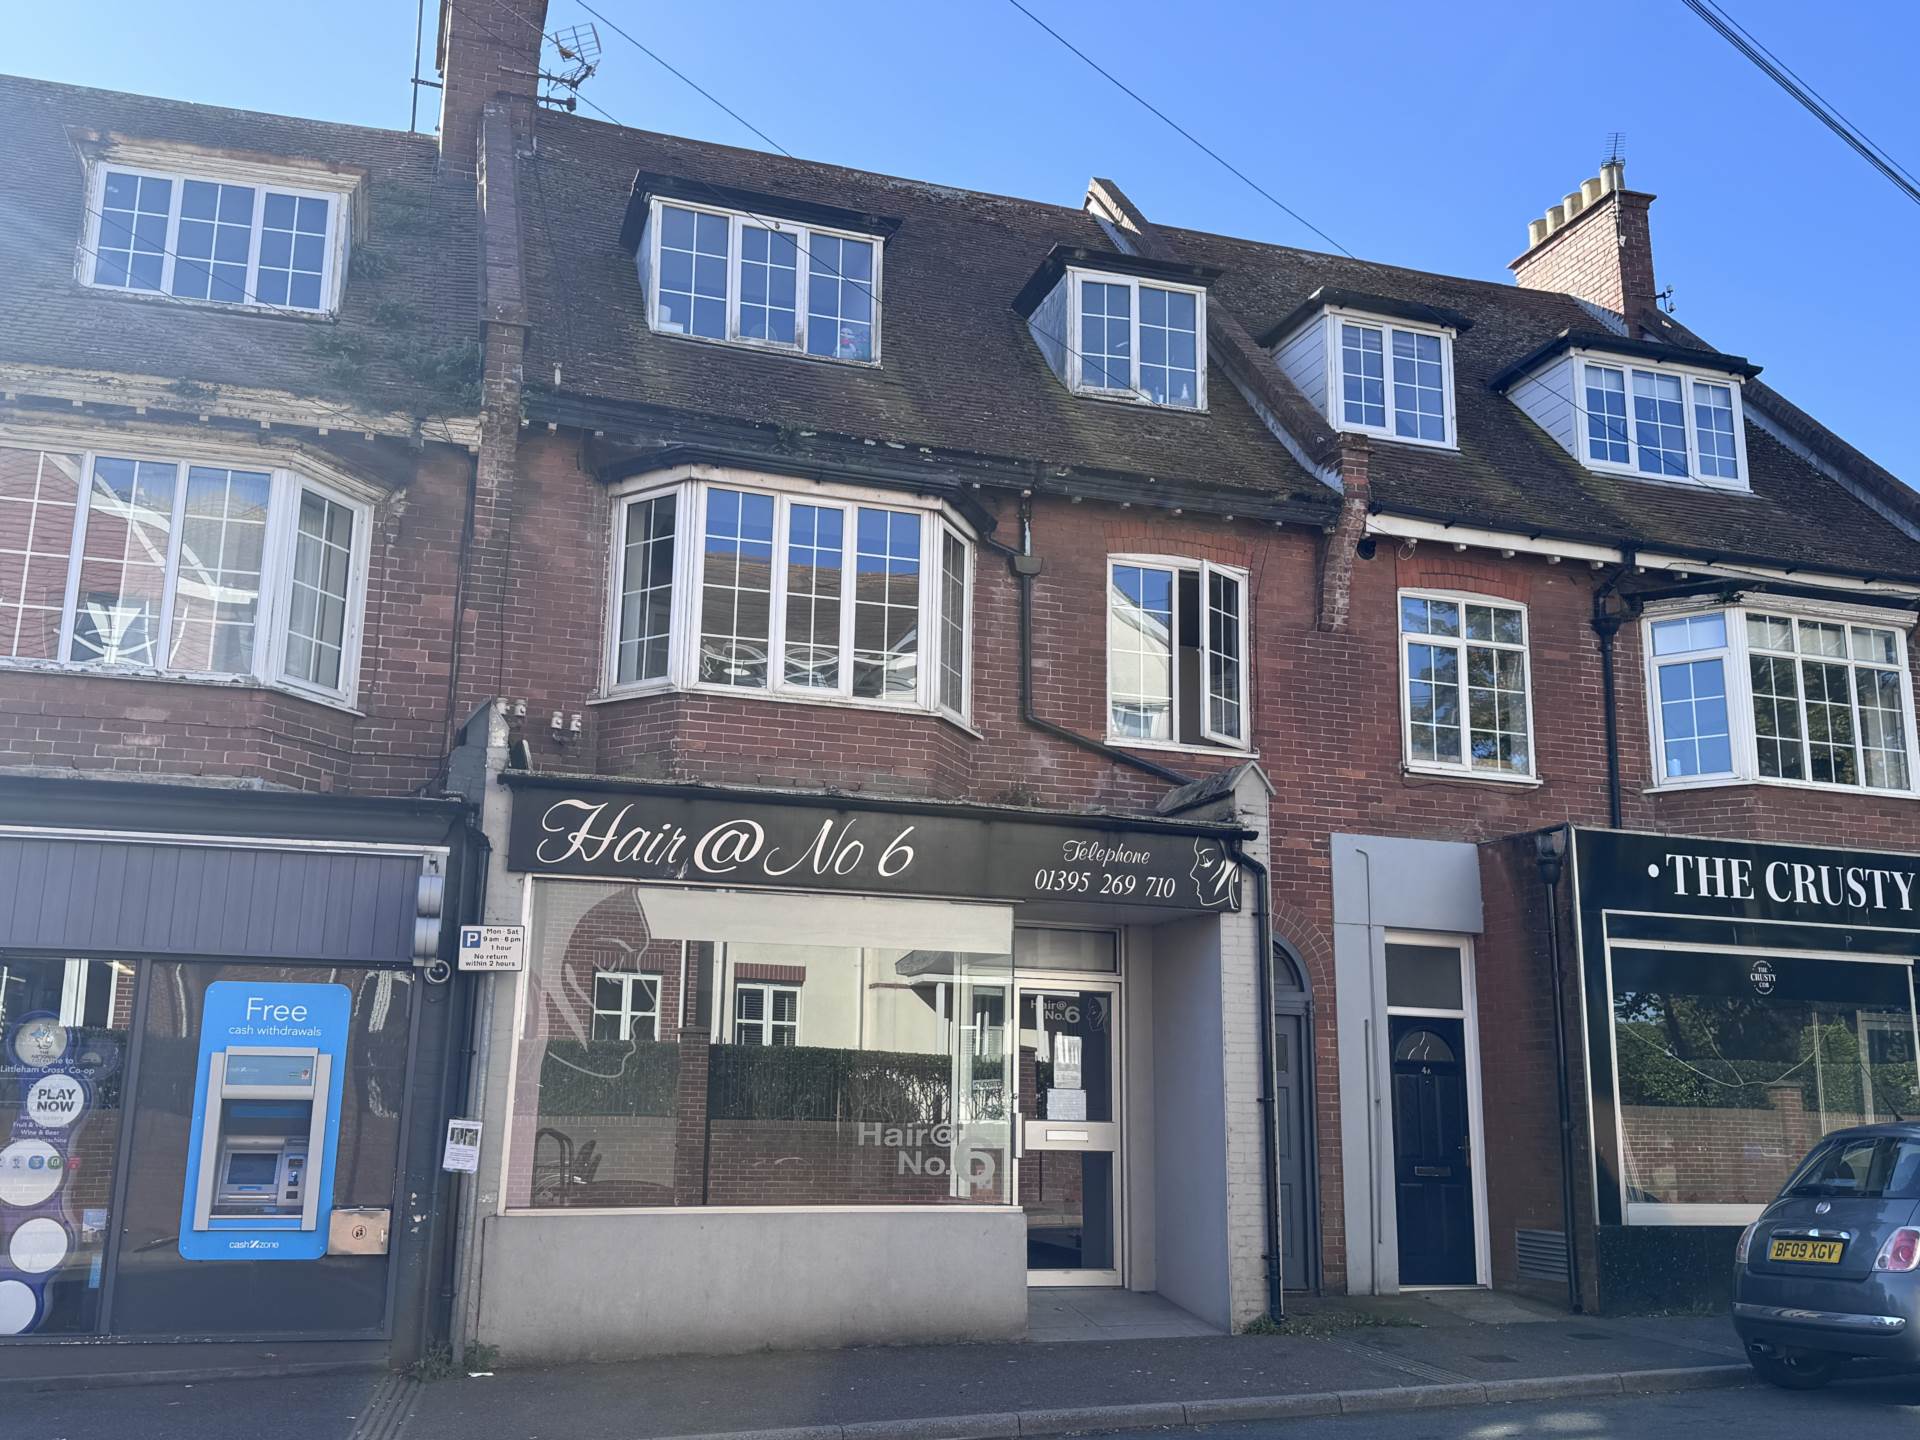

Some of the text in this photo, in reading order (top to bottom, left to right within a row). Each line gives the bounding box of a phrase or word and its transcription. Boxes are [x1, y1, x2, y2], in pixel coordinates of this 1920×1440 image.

[536, 799, 915, 877] Hair @ No 6
[1062, 840, 1151, 867] Telephone
[1034, 868, 1177, 898] 01395 269 710
[1665, 853, 1916, 911] THE CRUSTY
[466, 932, 479, 947] P
[246, 997, 308, 1022] Free
[228, 1025, 322, 1037] cash withdrawals
[64, 1057, 74, 1065] to
[0, 1063, 40, 1073] Littleham
[69, 1066, 95, 1076] Co-op
[37, 1088, 77, 1100] PLAY
[36, 1101, 75, 1112] NOW
[1774, 1242, 1837, 1259] BF09 XGV
